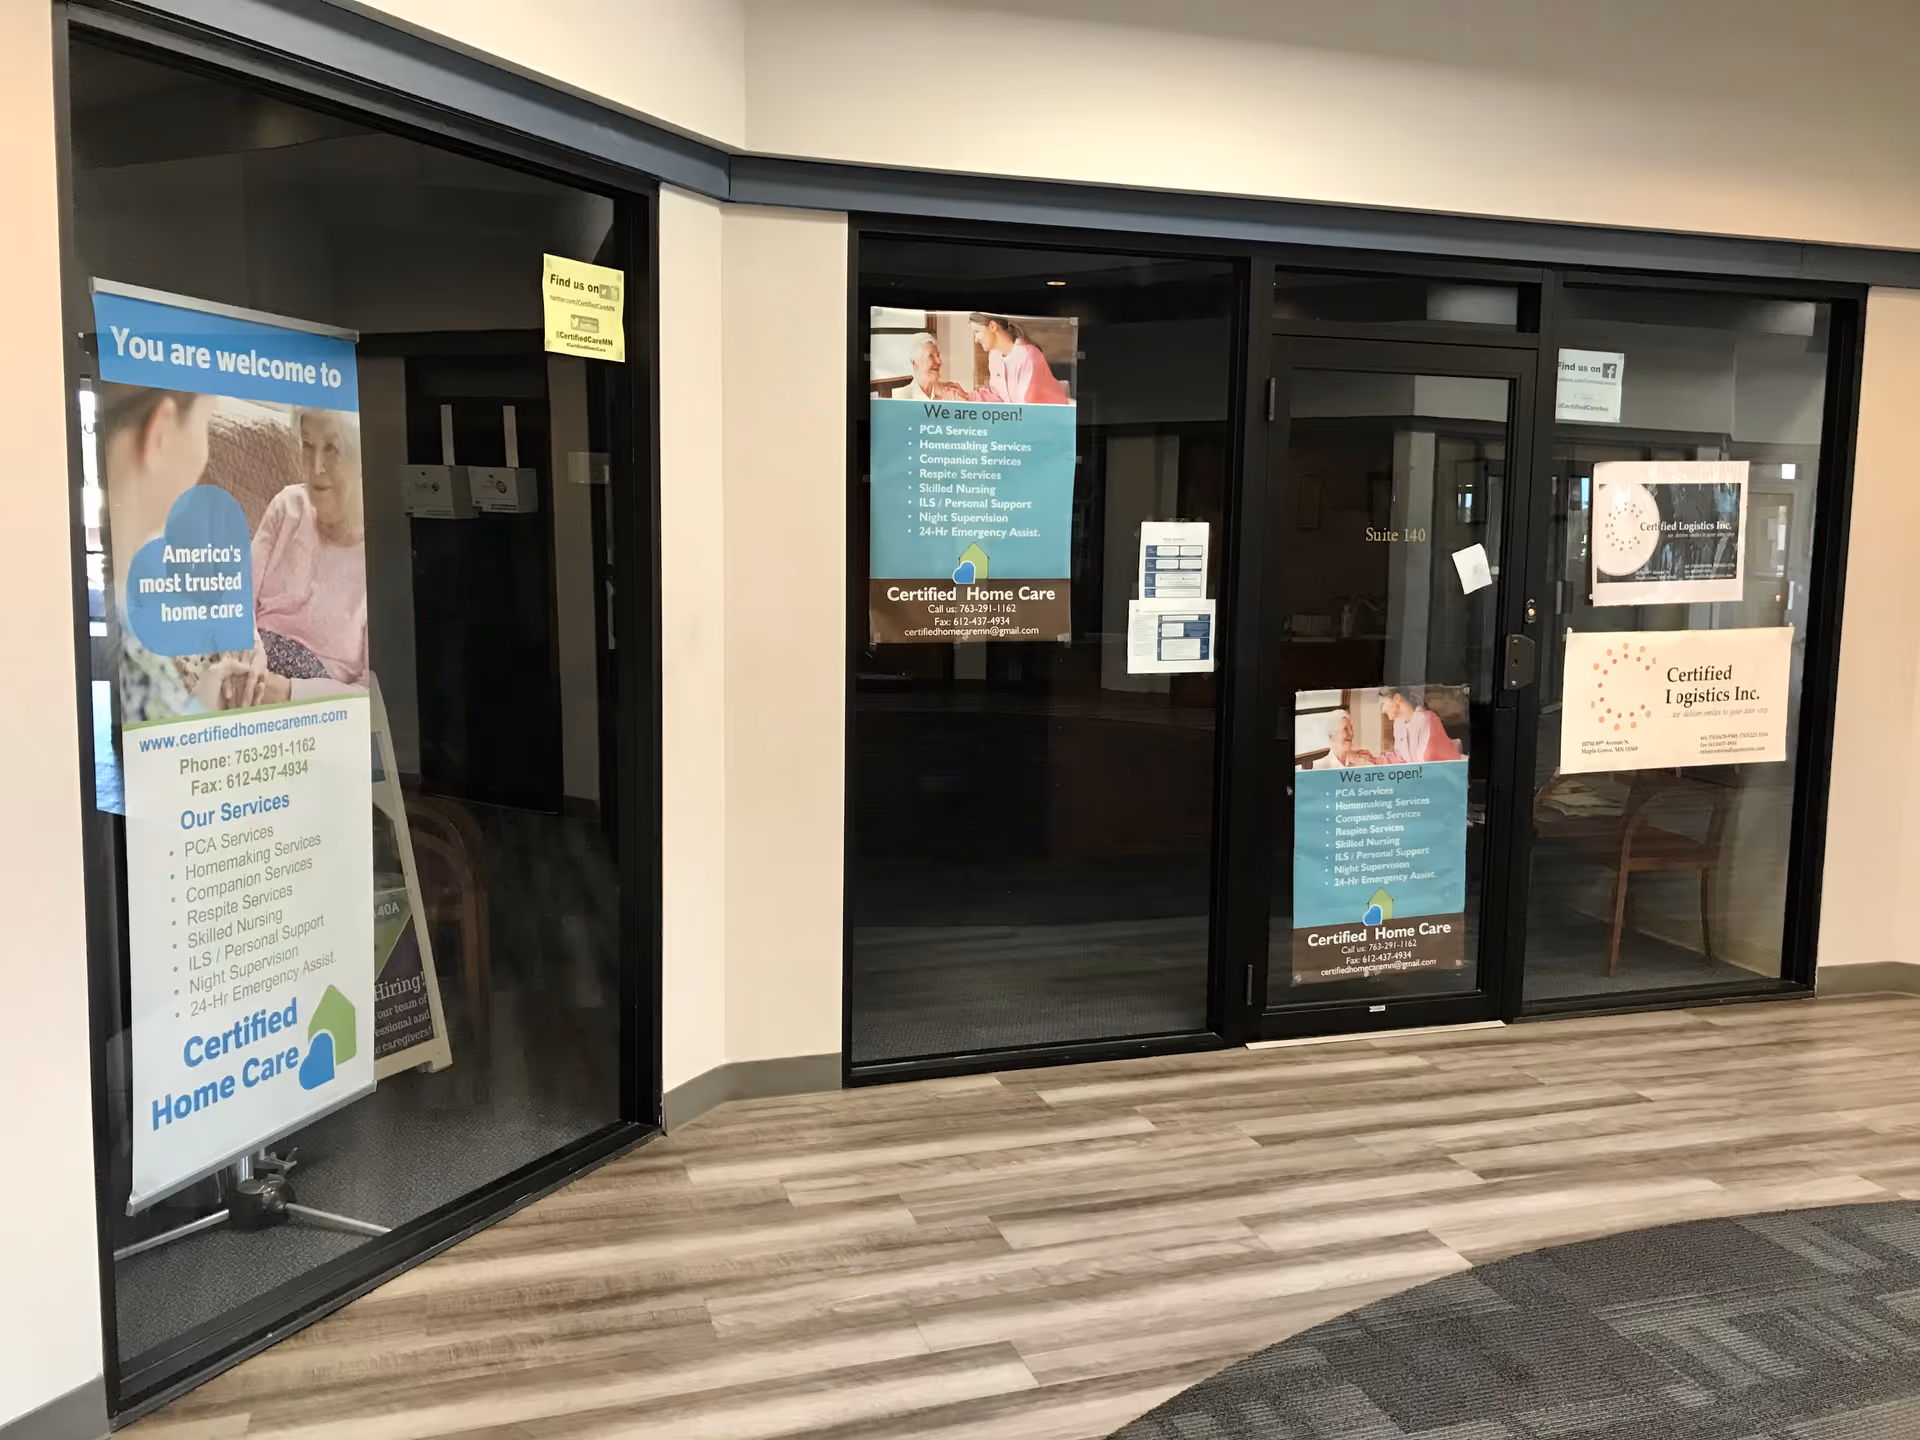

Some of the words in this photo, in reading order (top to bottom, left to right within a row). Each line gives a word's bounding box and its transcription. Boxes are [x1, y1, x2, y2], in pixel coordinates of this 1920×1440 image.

[550, 273, 571, 288] Find
[573, 281, 585, 291] us
[587, 284, 599, 294] on
[110, 325, 164, 363] You
[170, 342, 211, 369] are
[216, 349, 316, 385] welcome
[320, 362, 342, 388] to
[923, 404, 950, 419] We
[954, 407, 977, 420] are
[981, 407, 1023, 424] open!
[919, 424, 943, 435] PCA
[946, 425, 988, 437] Services
[919, 440, 988, 453] Homemaking
[990, 441, 1032, 452] Services
[919, 454, 978, 466] Companion
[981, 455, 1022, 466] Services
[919, 469, 958, 481] Respite
[960, 470, 1001, 480] Services
[919, 483, 953, 494] Skilled
[956, 484, 996, 496] Nursing
[919, 498, 936, 508] ILS
[944, 499, 988, 509] Personal
[990, 499, 1032, 511] Support
[919, 512, 948, 524] Night
[951, 512, 1008, 524] Supervision
[919, 527, 949, 537] 24-Hr
[951, 527, 1007, 539] Emergency
[1009, 527, 1041, 537] Assist.
[1365, 526, 1399, 542] Suite
[1403, 528, 1426, 542] 140
[1679, 521, 1715, 533] Logistics
[1716, 521, 1732, 530] Inc.
[162, 543, 241, 563] America's
[139, 573, 182, 593] most
[185, 572, 242, 592] trusted
[886, 586, 957, 601] Certified
[966, 586, 1014, 601] Home
[1018, 586, 1056, 601] Care
[161, 603, 207, 622] home
[210, 603, 243, 619] care
[927, 604, 944, 614] Call
[945, 606, 957, 614] us:
[959, 604, 1016, 614] 763-291-1162
[934, 617, 951, 626] Fax:
[953, 617, 1010, 626] 612-437-4934
[904, 626, 1040, 638] certifiedhomecaremn@gmail.com
[1666, 664, 1732, 683] Certified
[1734, 686, 1760, 701] Inc.
[139, 708, 348, 753] www.certifiedhomecaremn.com
[179, 754, 231, 775] Phone:
[235, 736, 316, 764] 763-291-1162
[191, 777, 222, 796] Fax:
[226, 759, 308, 789] 612-437-4934
[1339, 770, 1361, 783] We
[1364, 771, 1384, 783] are
[1388, 766, 1423, 783] open!
[1335, 788, 1355, 798] PCA
[1357, 787, 1394, 797] Services
[181, 809, 215, 830] Our
[220, 794, 289, 822] Services
[1335, 799, 1392, 811] Homemaking
[1395, 797, 1430, 806] Services
[1335, 812, 1384, 824] Companion
[1386, 810, 1421, 820] Services
[1335, 826, 1368, 837] Respite
[1369, 823, 1404, 834] Services
[184, 837, 217, 857] PCA
[221, 825, 274, 849] Services
[1335, 839, 1364, 849] Skilled
[1366, 836, 1400, 847] Nursing
[185, 848, 271, 880] Homemaking
[274, 834, 321, 857] Services
[1335, 852, 1349, 861] ILS
[1356, 849, 1393, 860] Personal
[1395, 846, 1430, 857] Support
[1334, 864, 1359, 875] Night
[1361, 861, 1410, 873] Supervision
[186, 872, 261, 903] Companion
[264, 857, 313, 881] Services
[1334, 876, 1359, 887] 24-Hr
[1361, 873, 1408, 885] Emergency
[1409, 871, 1437, 880] Assist.
[187, 900, 238, 926] Respite
[242, 884, 293, 910] Services
[188, 922, 232, 949] Skilled
[236, 909, 283, 934] Nursing
[1307, 928, 1368, 947] Certified
[1375, 926, 1415, 940] Home
[1418, 922, 1451, 936] Care
[188, 951, 212, 971] ILS
[224, 929, 278, 960] Personal
[282, 914, 325, 940] Support
[1341, 946, 1355, 955] Call
[1356, 945, 1367, 953] us:
[1368, 939, 1417, 952] 763-291-1162
[1346, 956, 1361, 965] Fax:
[1362, 951, 1412, 964] 612-437-4934
[189, 970, 226, 994] Night
[229, 946, 299, 981] Supervision
[1320, 959, 1437, 976] certifiedhomecaremn@gmail.com
[190, 992, 228, 1018] 24-Hr
[232, 965, 299, 1001] Emergency
[302, 951, 337, 976] Assist.
[374, 970, 426, 1001] Hiring!
[377, 1007, 393, 1020] our
[394, 1000, 417, 1013] team
[412, 1009, 431, 1023] and
[183, 997, 298, 1068] Certified
[382, 1027, 433, 1052] caregivers!
[151, 1075, 235, 1131] Home
[242, 1046, 299, 1088] Care
